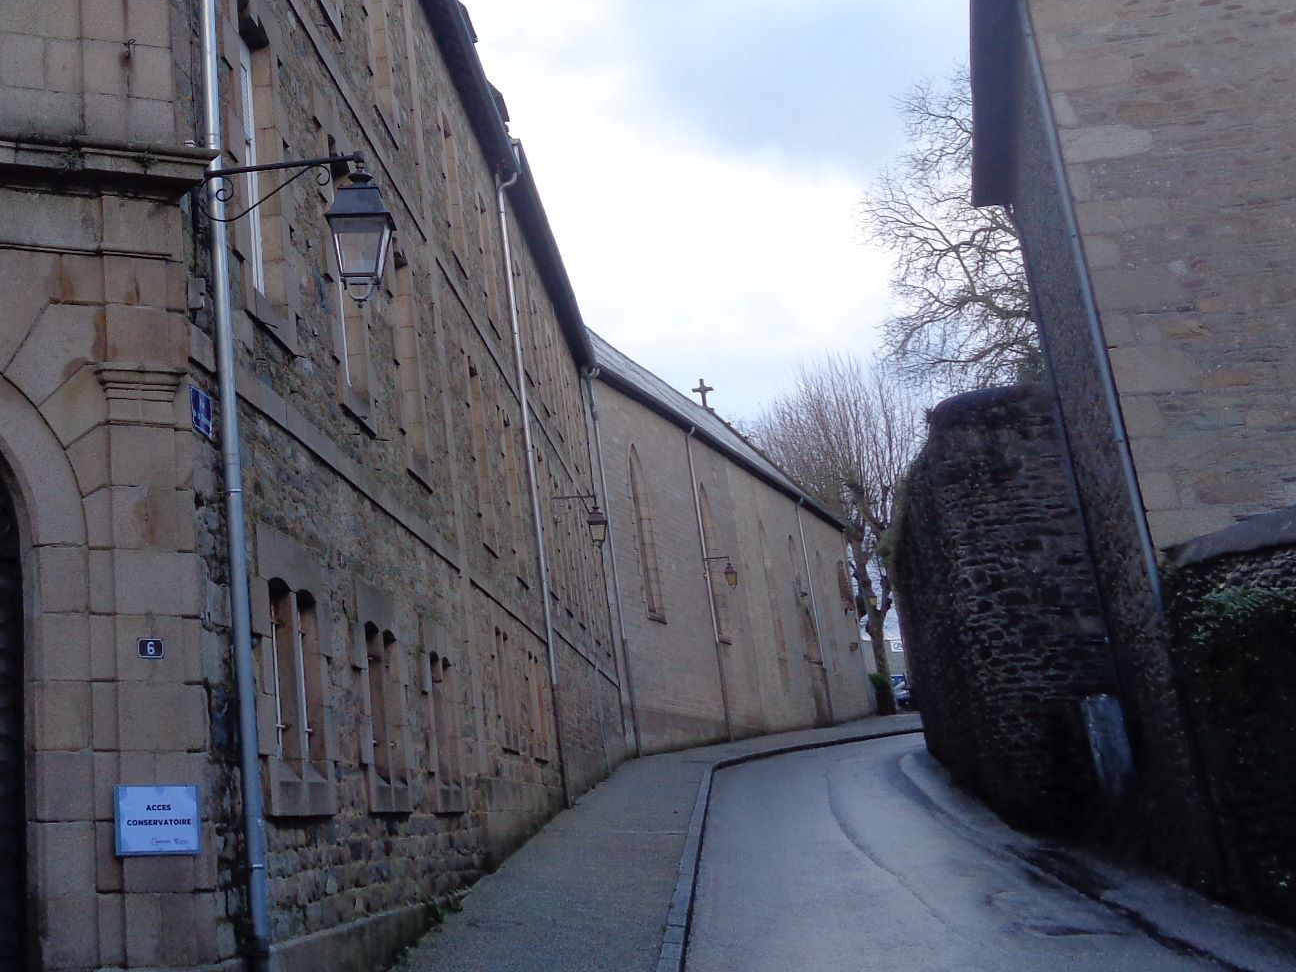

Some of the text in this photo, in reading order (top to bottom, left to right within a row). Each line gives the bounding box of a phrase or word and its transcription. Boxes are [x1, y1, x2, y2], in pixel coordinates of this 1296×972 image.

[147, 641, 155, 655] 6
[145, 804, 172, 812] ACCES
[126, 818, 192, 827] CONSERVATOIRE
